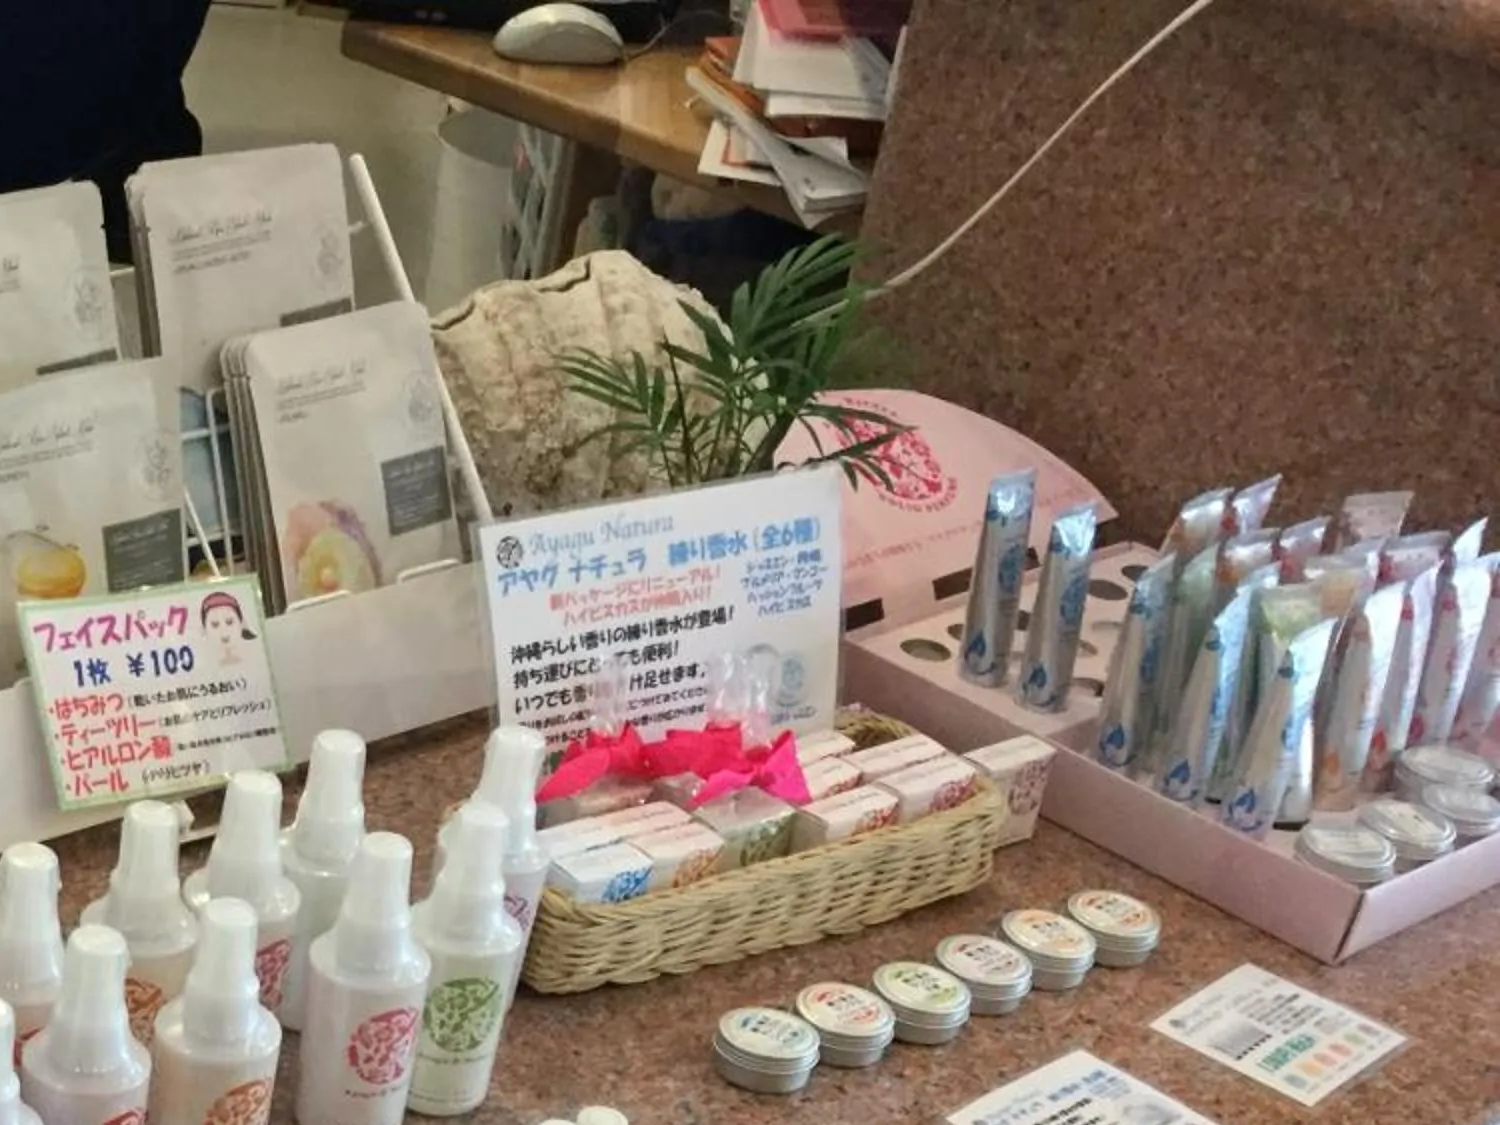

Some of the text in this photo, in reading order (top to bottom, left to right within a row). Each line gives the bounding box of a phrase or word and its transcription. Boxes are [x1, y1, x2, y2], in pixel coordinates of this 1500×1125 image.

[33, 605, 189, 652] フェイスパック
[73, 645, 195, 687] 1枚 ¥100
